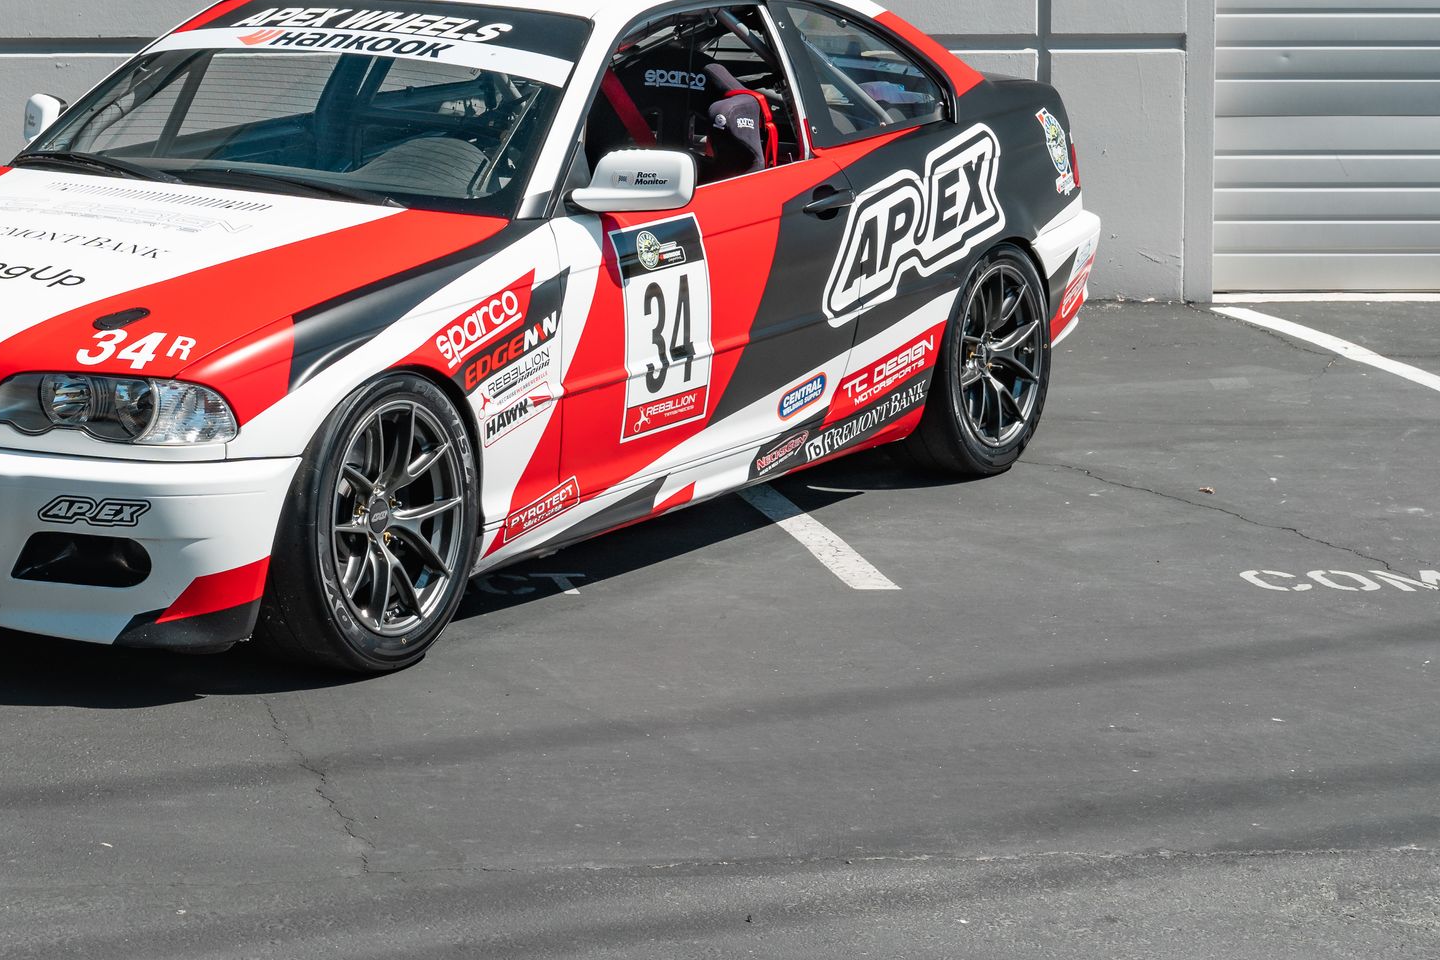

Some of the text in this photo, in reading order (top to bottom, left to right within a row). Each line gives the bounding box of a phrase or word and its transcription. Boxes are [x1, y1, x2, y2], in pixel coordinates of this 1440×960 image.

[230, 7, 513, 42] APEX WHEELS
[645, 69, 707, 88] sparco
[634, 177, 668, 185] Monitor
[838, 148, 991, 296] APEX
[80, 236, 172, 260] BANK
[435, 290, 519, 363] sparco
[643, 273, 696, 394] 34
[75, 328, 197, 370] 34 R
[843, 334, 935, 398] TC DESIGN
[487, 348, 550, 396] REBELLION
[783, 376, 823, 408] CENTRAL
[854, 358, 925, 406] MOTORSPORTS
[486, 397, 529, 440] HAWK
[645, 393, 696, 417] REBELLION
[823, 401, 891, 456] FREMONT
[888, 379, 927, 418] BANK
[43, 499, 144, 523] APEX
[510, 483, 574, 529] PYROTECT
